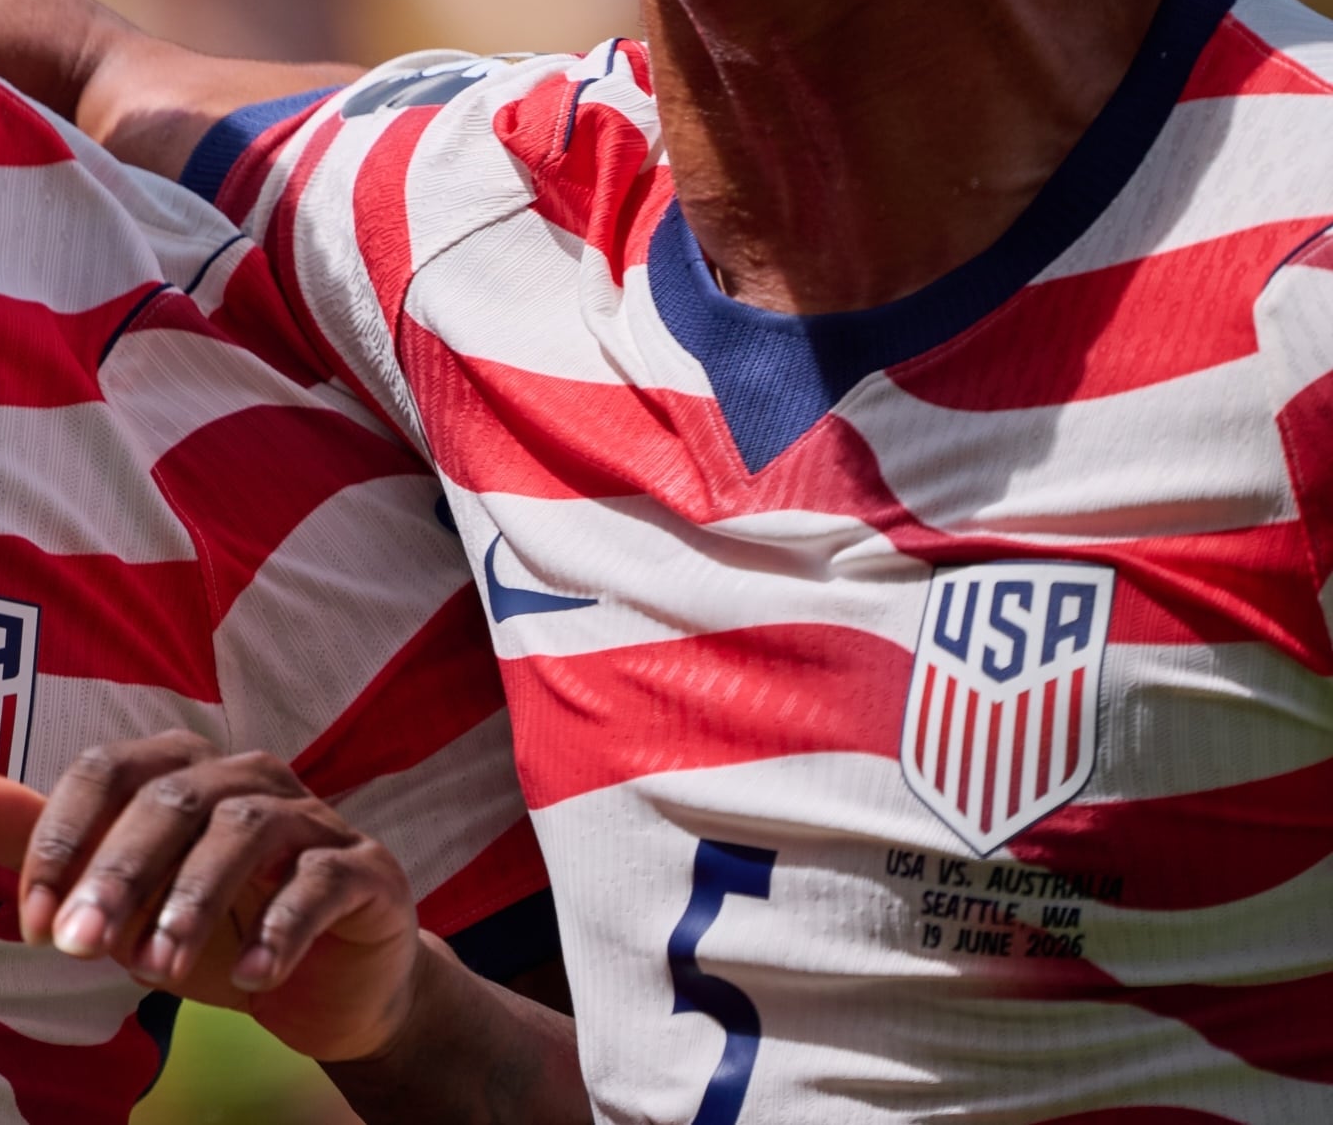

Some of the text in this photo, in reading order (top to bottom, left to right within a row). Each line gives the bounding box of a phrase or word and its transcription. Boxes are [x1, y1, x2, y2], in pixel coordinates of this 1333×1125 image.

[933, 581, 1097, 683] USA
[885, 849, 1125, 901] USA VS. AUSTRALIA
[920, 890, 1083, 929] SEATTLE, WA
[921, 923, 1085, 958] 19 JUNE 2026
[667, 838, 778, 1125] 5
